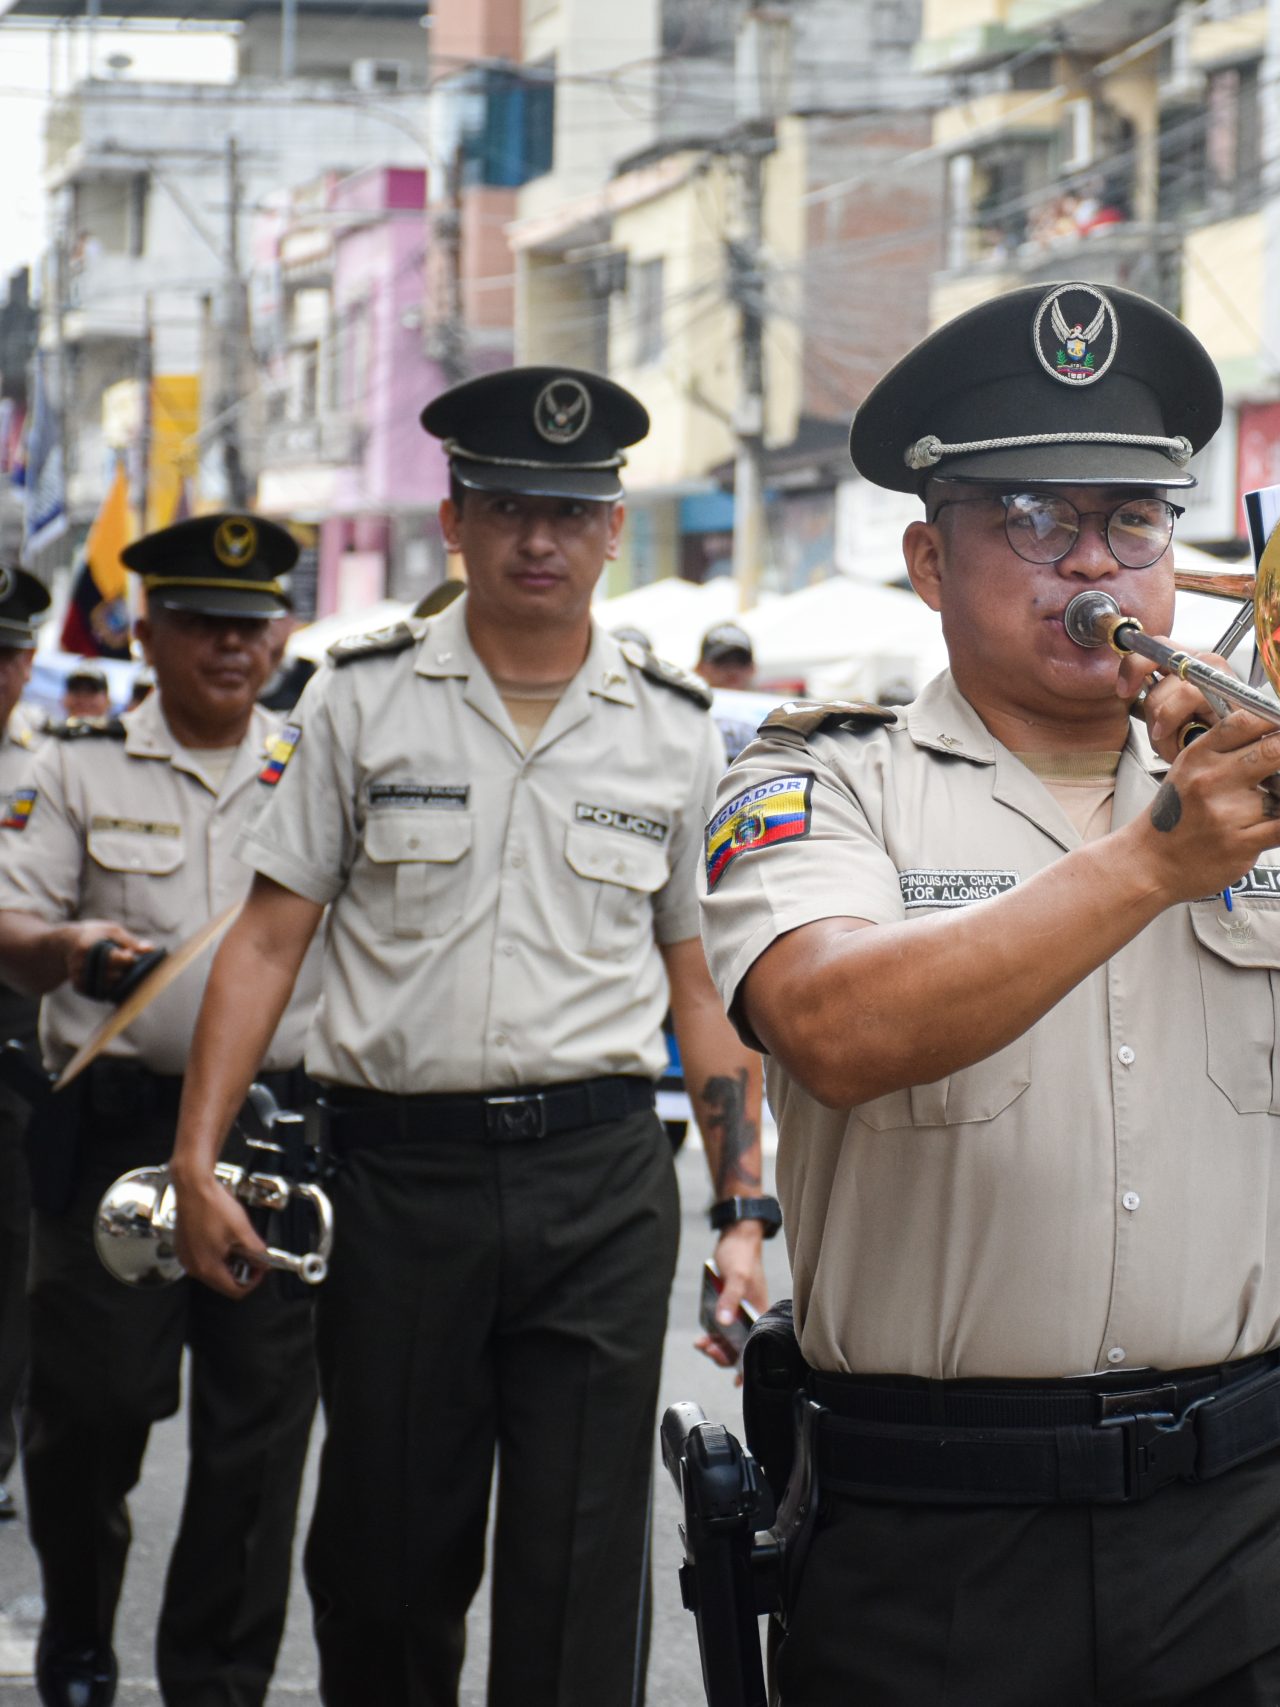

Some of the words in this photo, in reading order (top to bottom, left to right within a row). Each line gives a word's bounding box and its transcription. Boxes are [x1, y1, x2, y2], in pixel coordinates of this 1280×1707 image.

[710, 781, 802, 835] ECUADOR
[577, 804, 664, 838] POLICIA
[969, 875, 1017, 887] CHAFLA
[902, 887, 935, 901] TOR
[941, 886, 1000, 901] ALONSO
